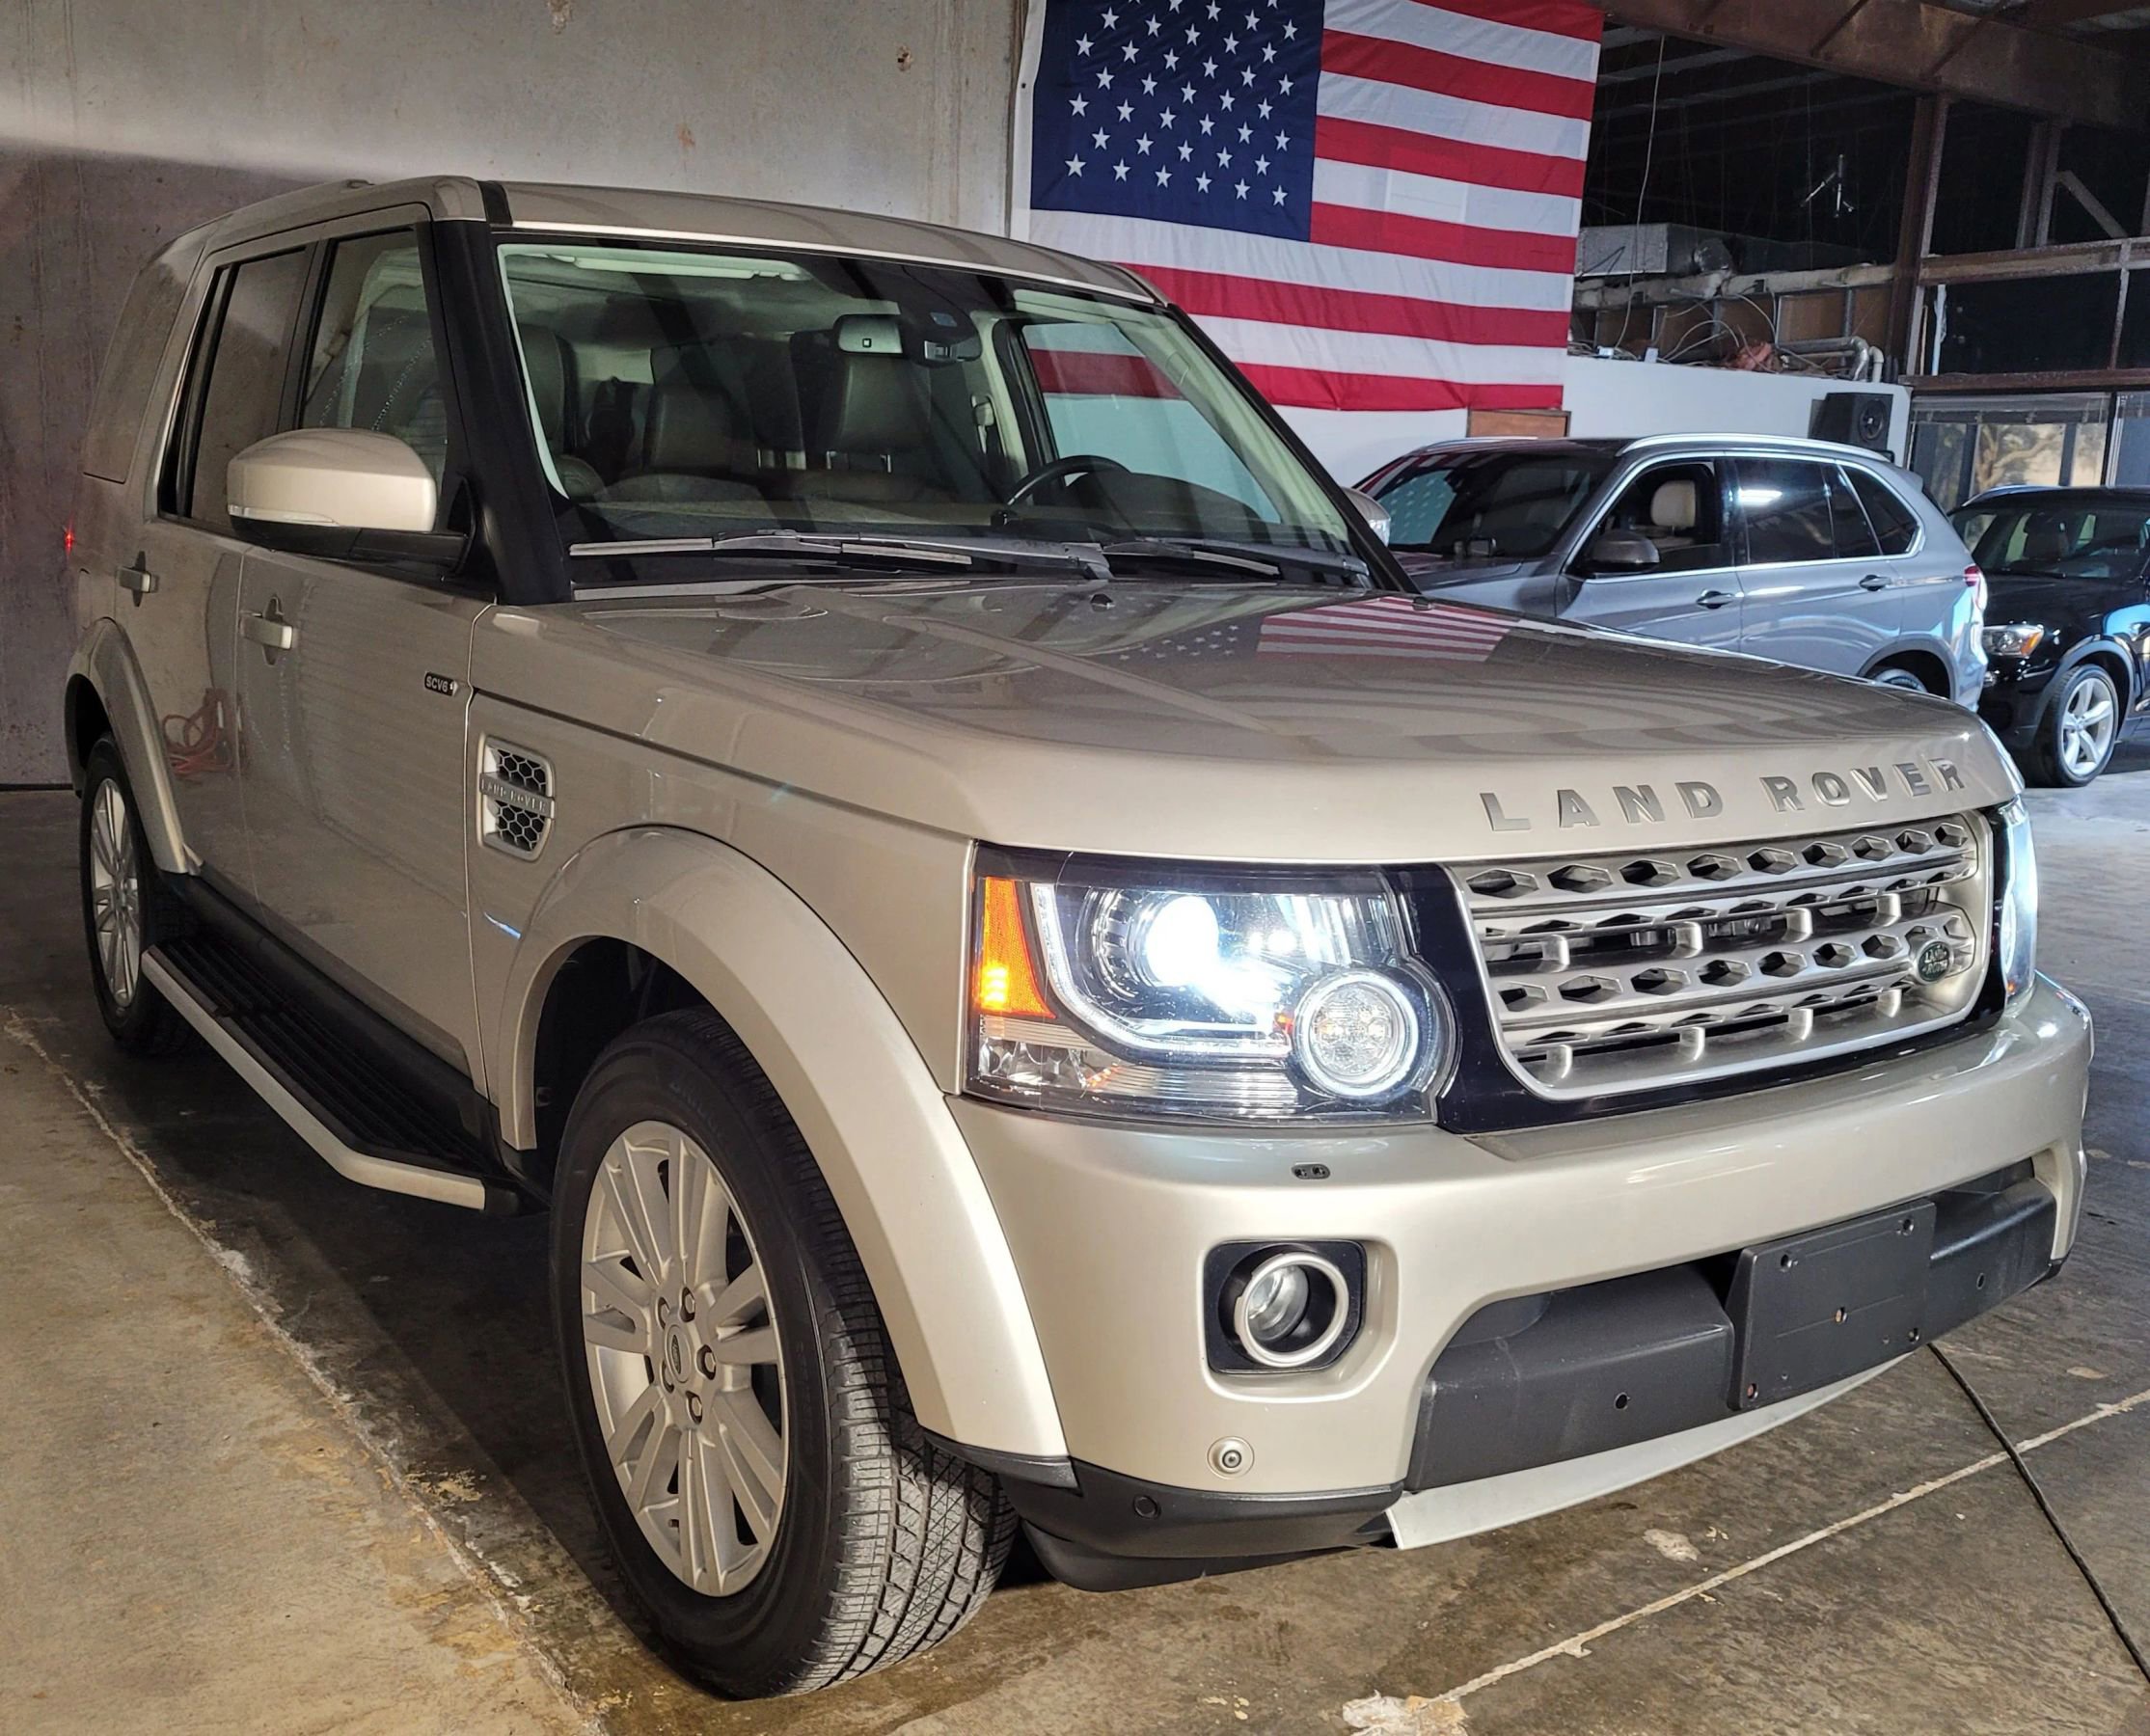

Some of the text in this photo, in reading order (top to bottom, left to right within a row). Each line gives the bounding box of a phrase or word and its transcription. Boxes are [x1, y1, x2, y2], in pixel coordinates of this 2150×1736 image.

[425, 675, 449, 692] SCV6
[1480, 758, 1965, 831] LAND ROVER
